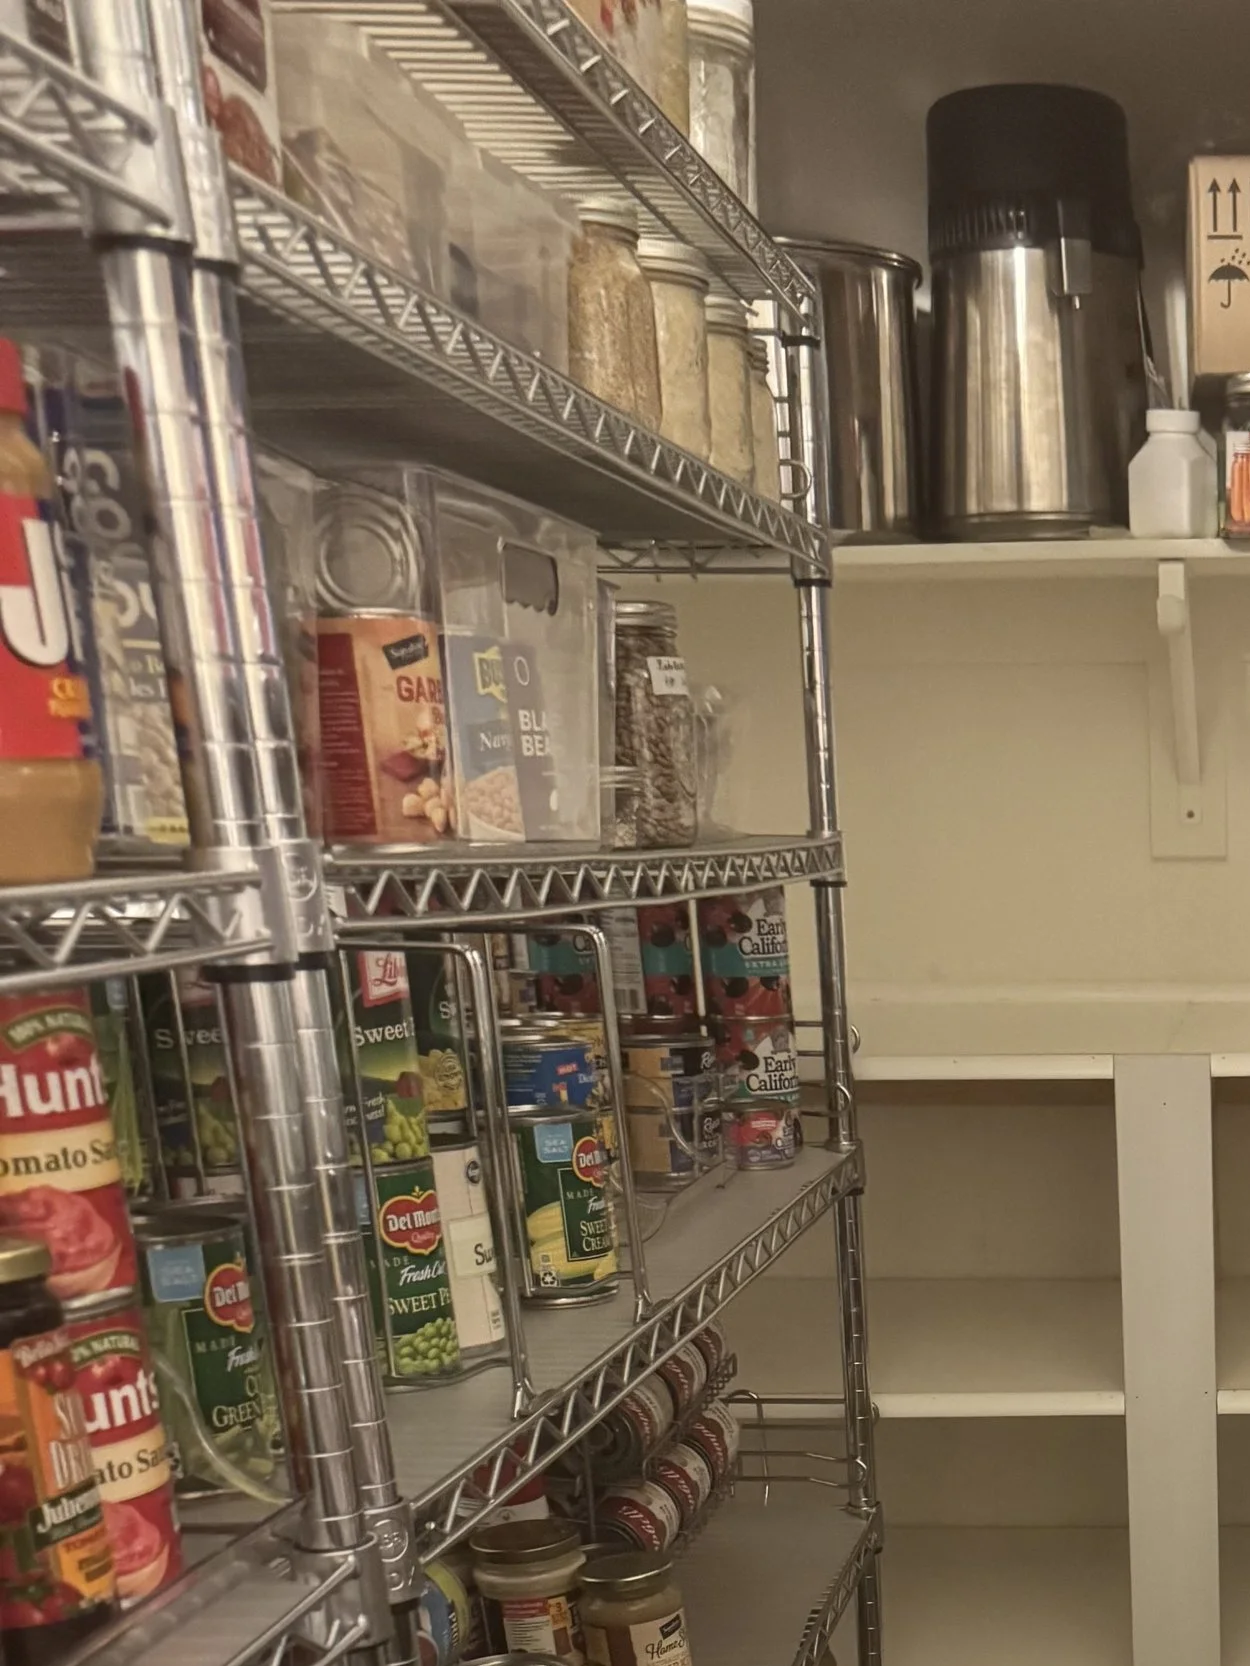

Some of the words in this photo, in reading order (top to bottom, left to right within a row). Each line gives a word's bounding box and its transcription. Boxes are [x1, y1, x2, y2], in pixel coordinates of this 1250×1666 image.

[353, 1019, 408, 1048] Sweet
[385, 1213, 412, 1233] Del
[399, 1264, 432, 1287] Fresh
